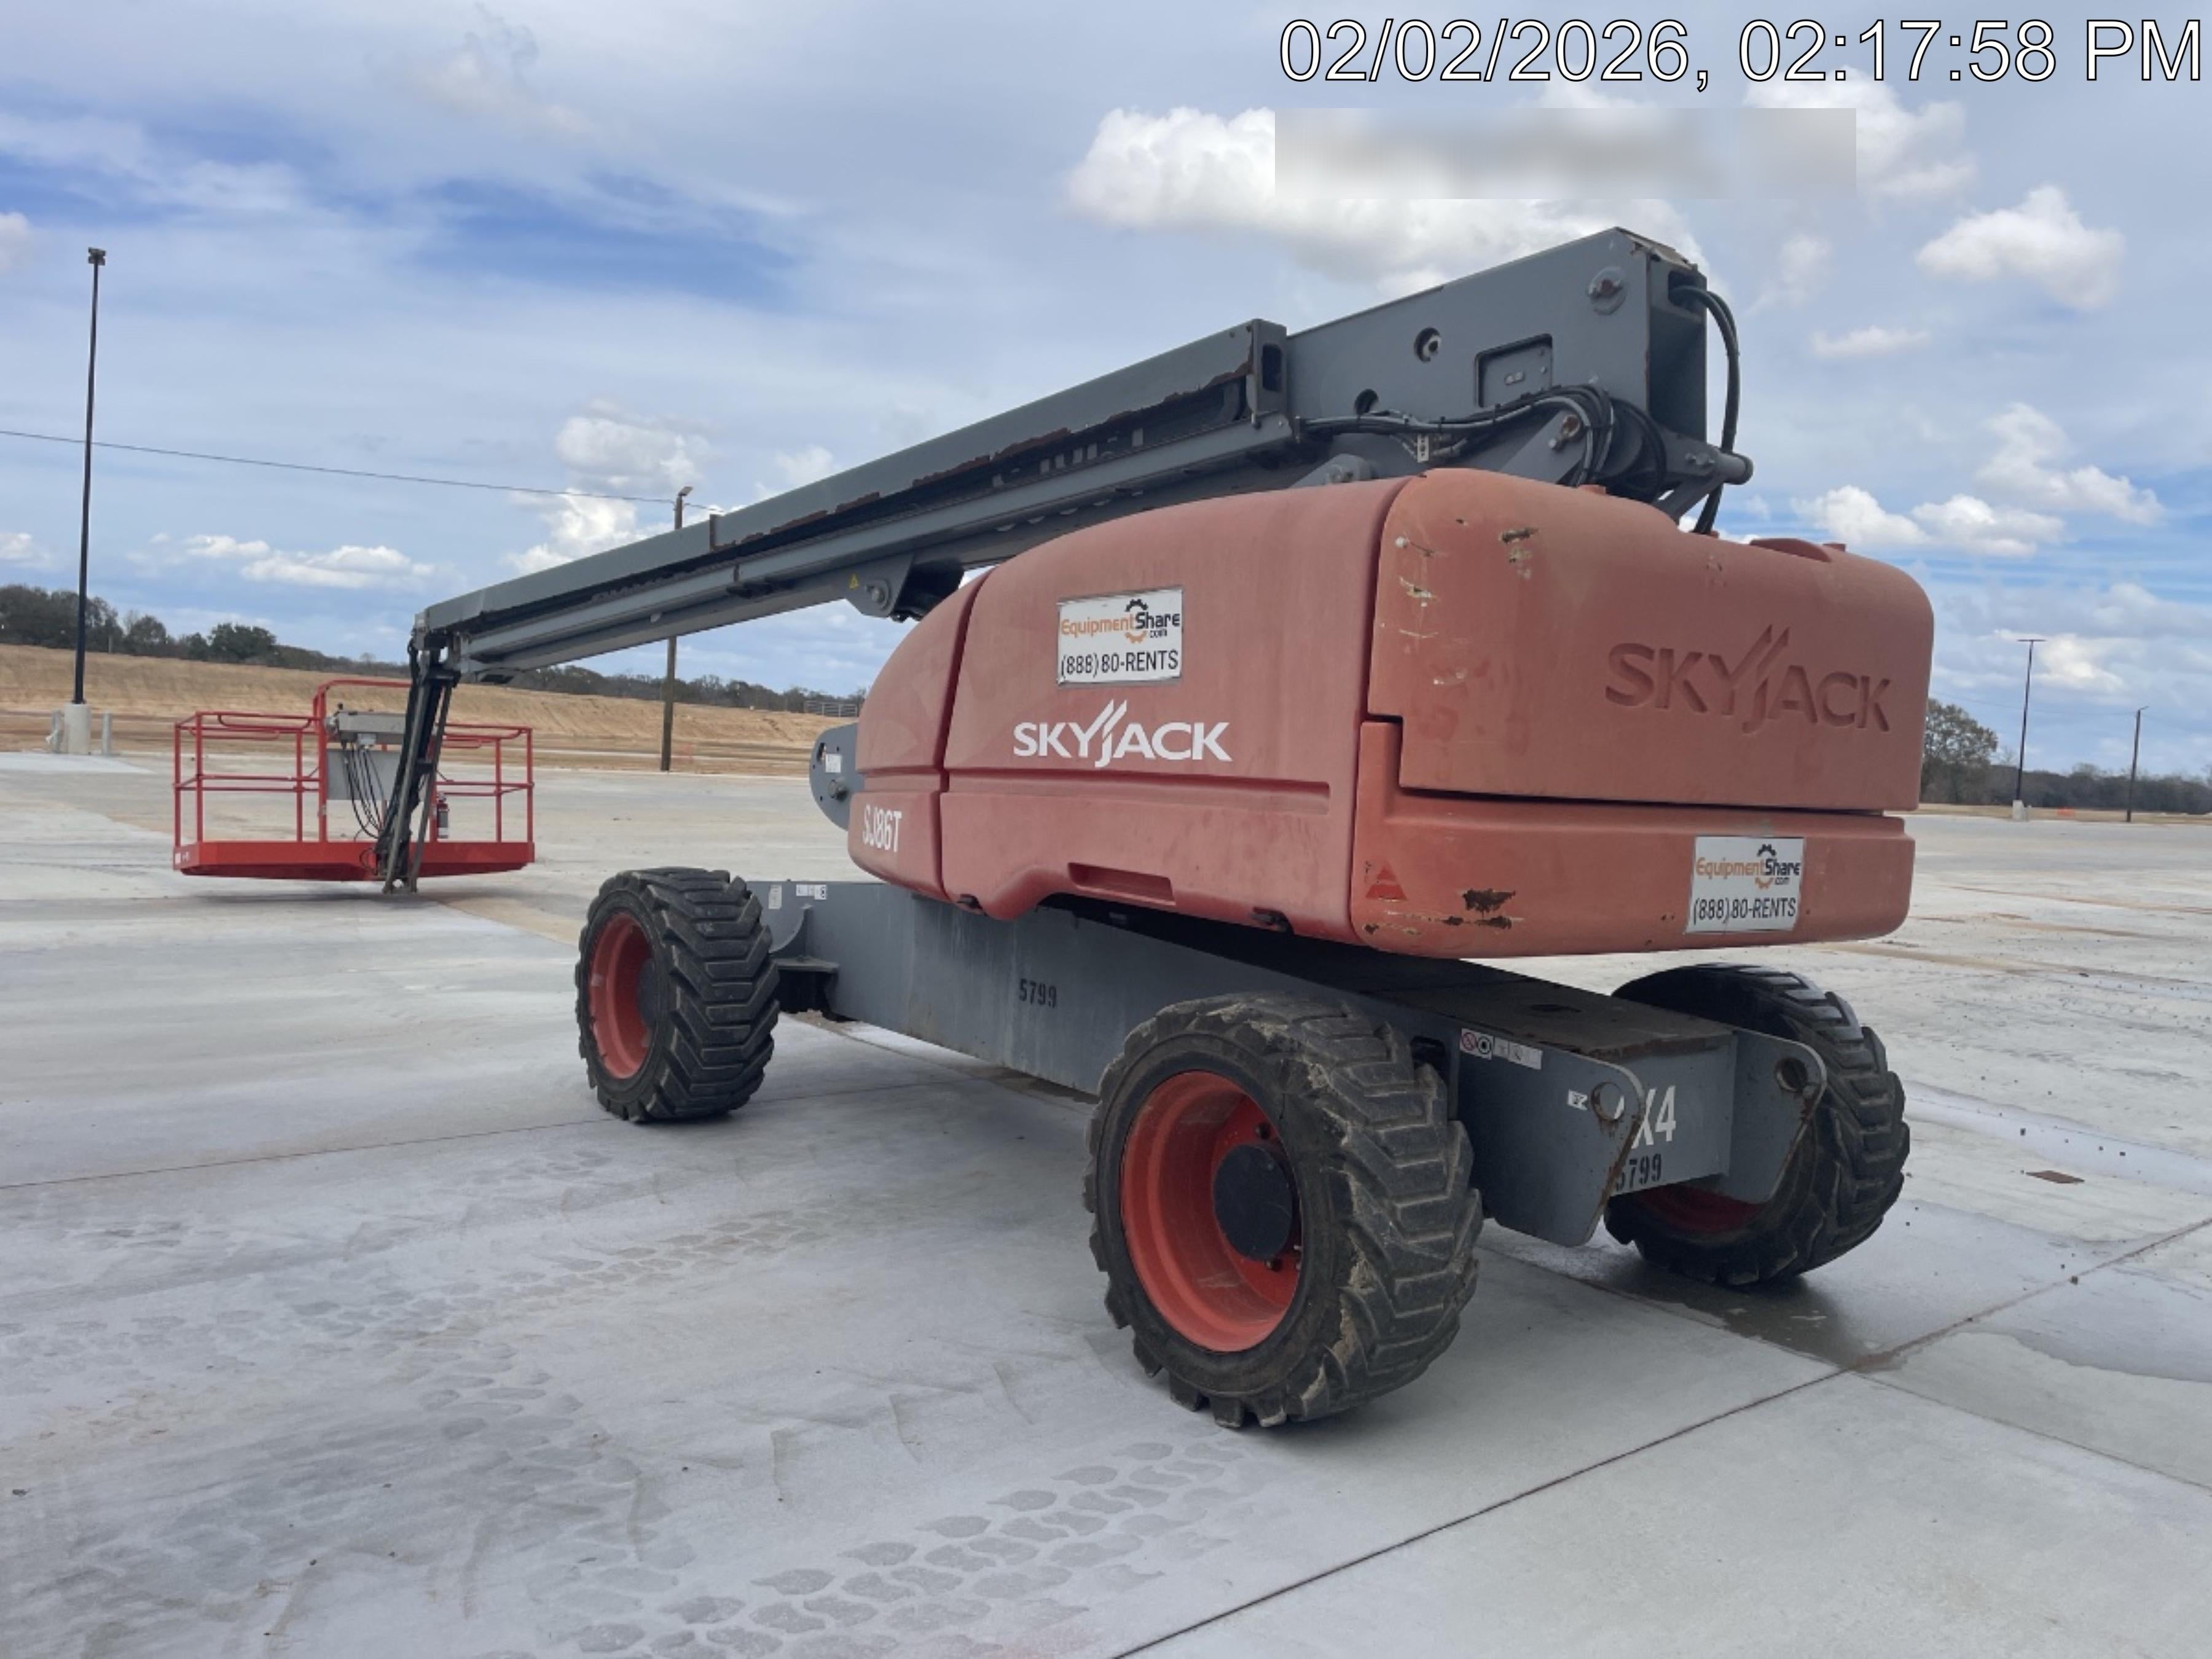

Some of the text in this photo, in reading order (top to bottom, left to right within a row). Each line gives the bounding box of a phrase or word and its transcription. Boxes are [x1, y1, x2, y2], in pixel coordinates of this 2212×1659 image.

[1062, 613, 1180, 637] EquipmentShare
[1061, 649, 1178, 678] (888) 80-RENTS
[1605, 624, 1891, 734] SKYJACK
[1013, 699, 1232, 767] SKYJACK
[863, 805, 902, 852] SJ86T
[1019, 979, 1057, 1008] 5799
